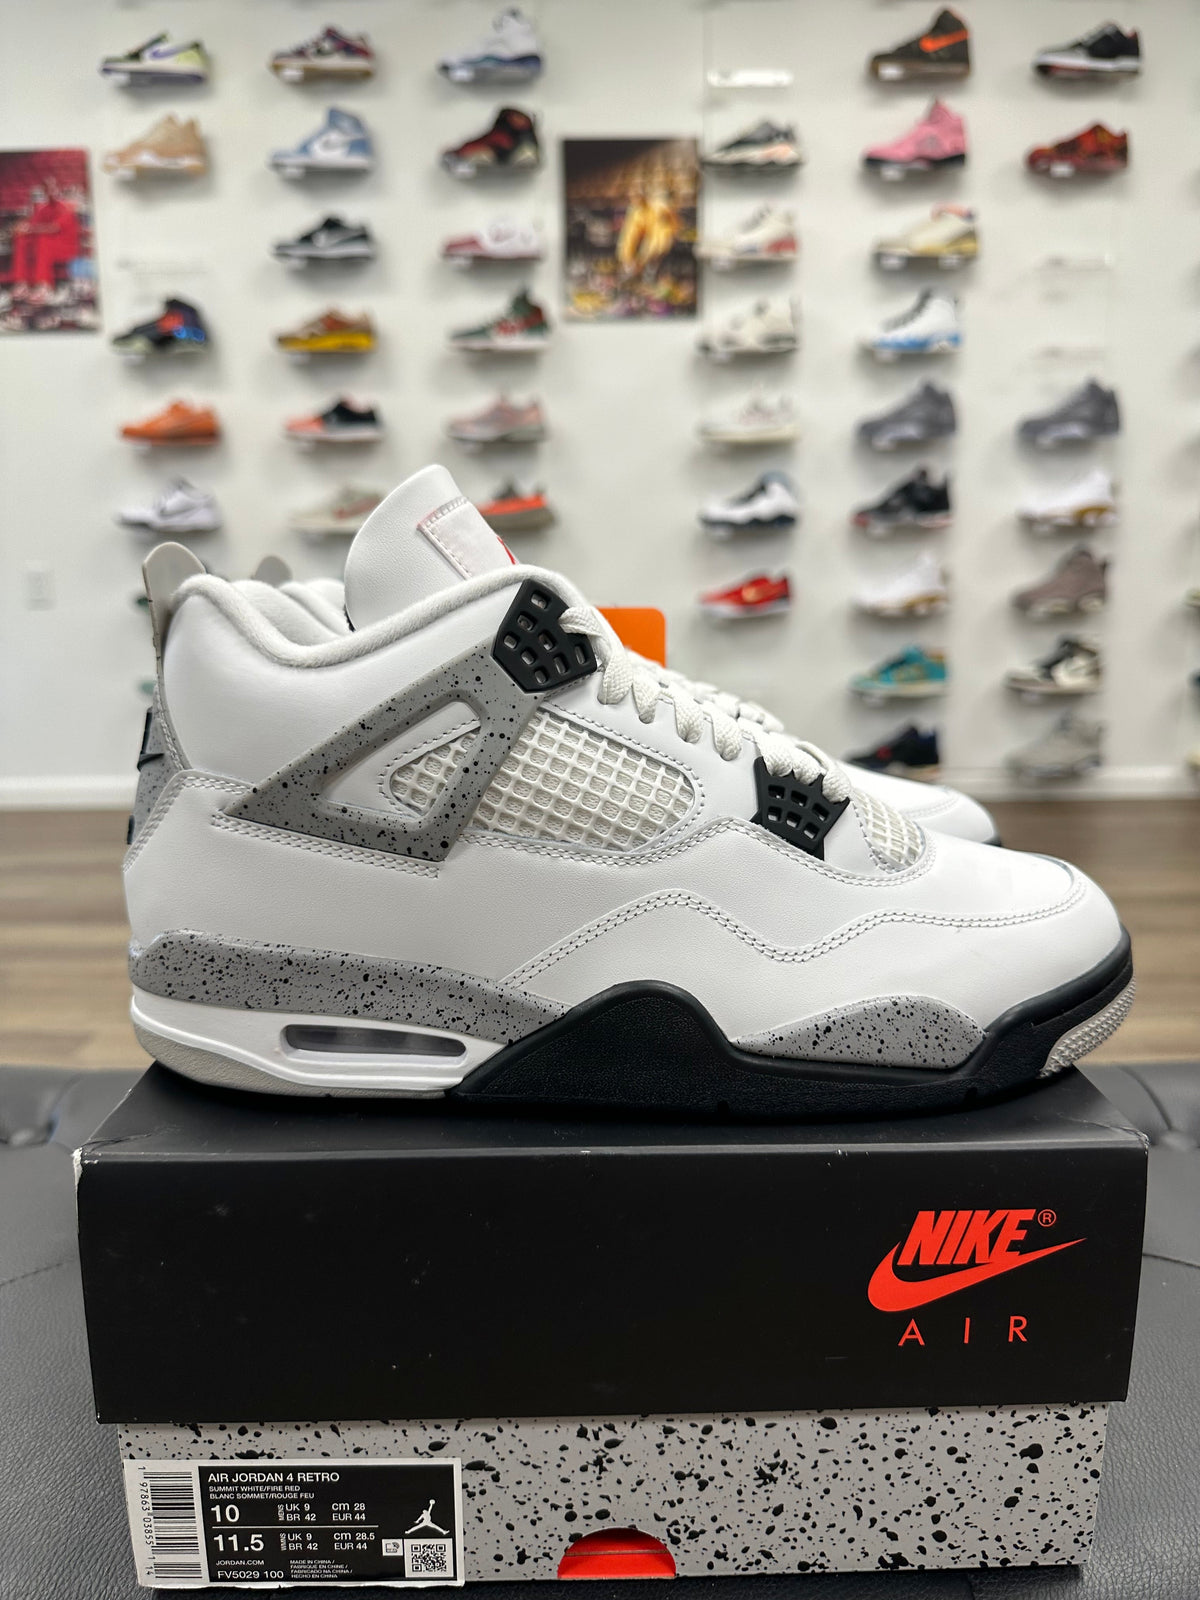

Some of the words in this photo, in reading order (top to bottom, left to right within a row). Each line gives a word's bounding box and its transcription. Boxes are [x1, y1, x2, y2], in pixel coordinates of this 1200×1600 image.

[208, 1473, 229, 1483] AIR
[232, 1473, 283, 1482] JORDAN
[286, 1473, 294, 1482] 4
[297, 1472, 340, 1482] RETRO
[285, 1503, 300, 1511] UK
[304, 1503, 310, 1511] 9
[331, 1502, 350, 1511] cm
[353, 1502, 366, 1511] 28
[210, 1504, 240, 1522] 10
[286, 1513, 300, 1521] BR
[304, 1513, 317, 1521] 42
[332, 1513, 352, 1521] EUR
[354, 1513, 366, 1521] 44
[287, 1532, 302, 1541] UK
[306, 1532, 312, 1541] 9
[333, 1532, 351, 1541] cm
[355, 1532, 375, 1541] 28.5
[213, 1533, 265, 1552] 11.5
[288, 1542, 303, 1551] BR
[306, 1542, 319, 1551] 42
[334, 1542, 354, 1550] EUR
[355, 1542, 368, 1550] 44
[217, 1570, 260, 1579] FV5029
[263, 1570, 284, 1579] 100
